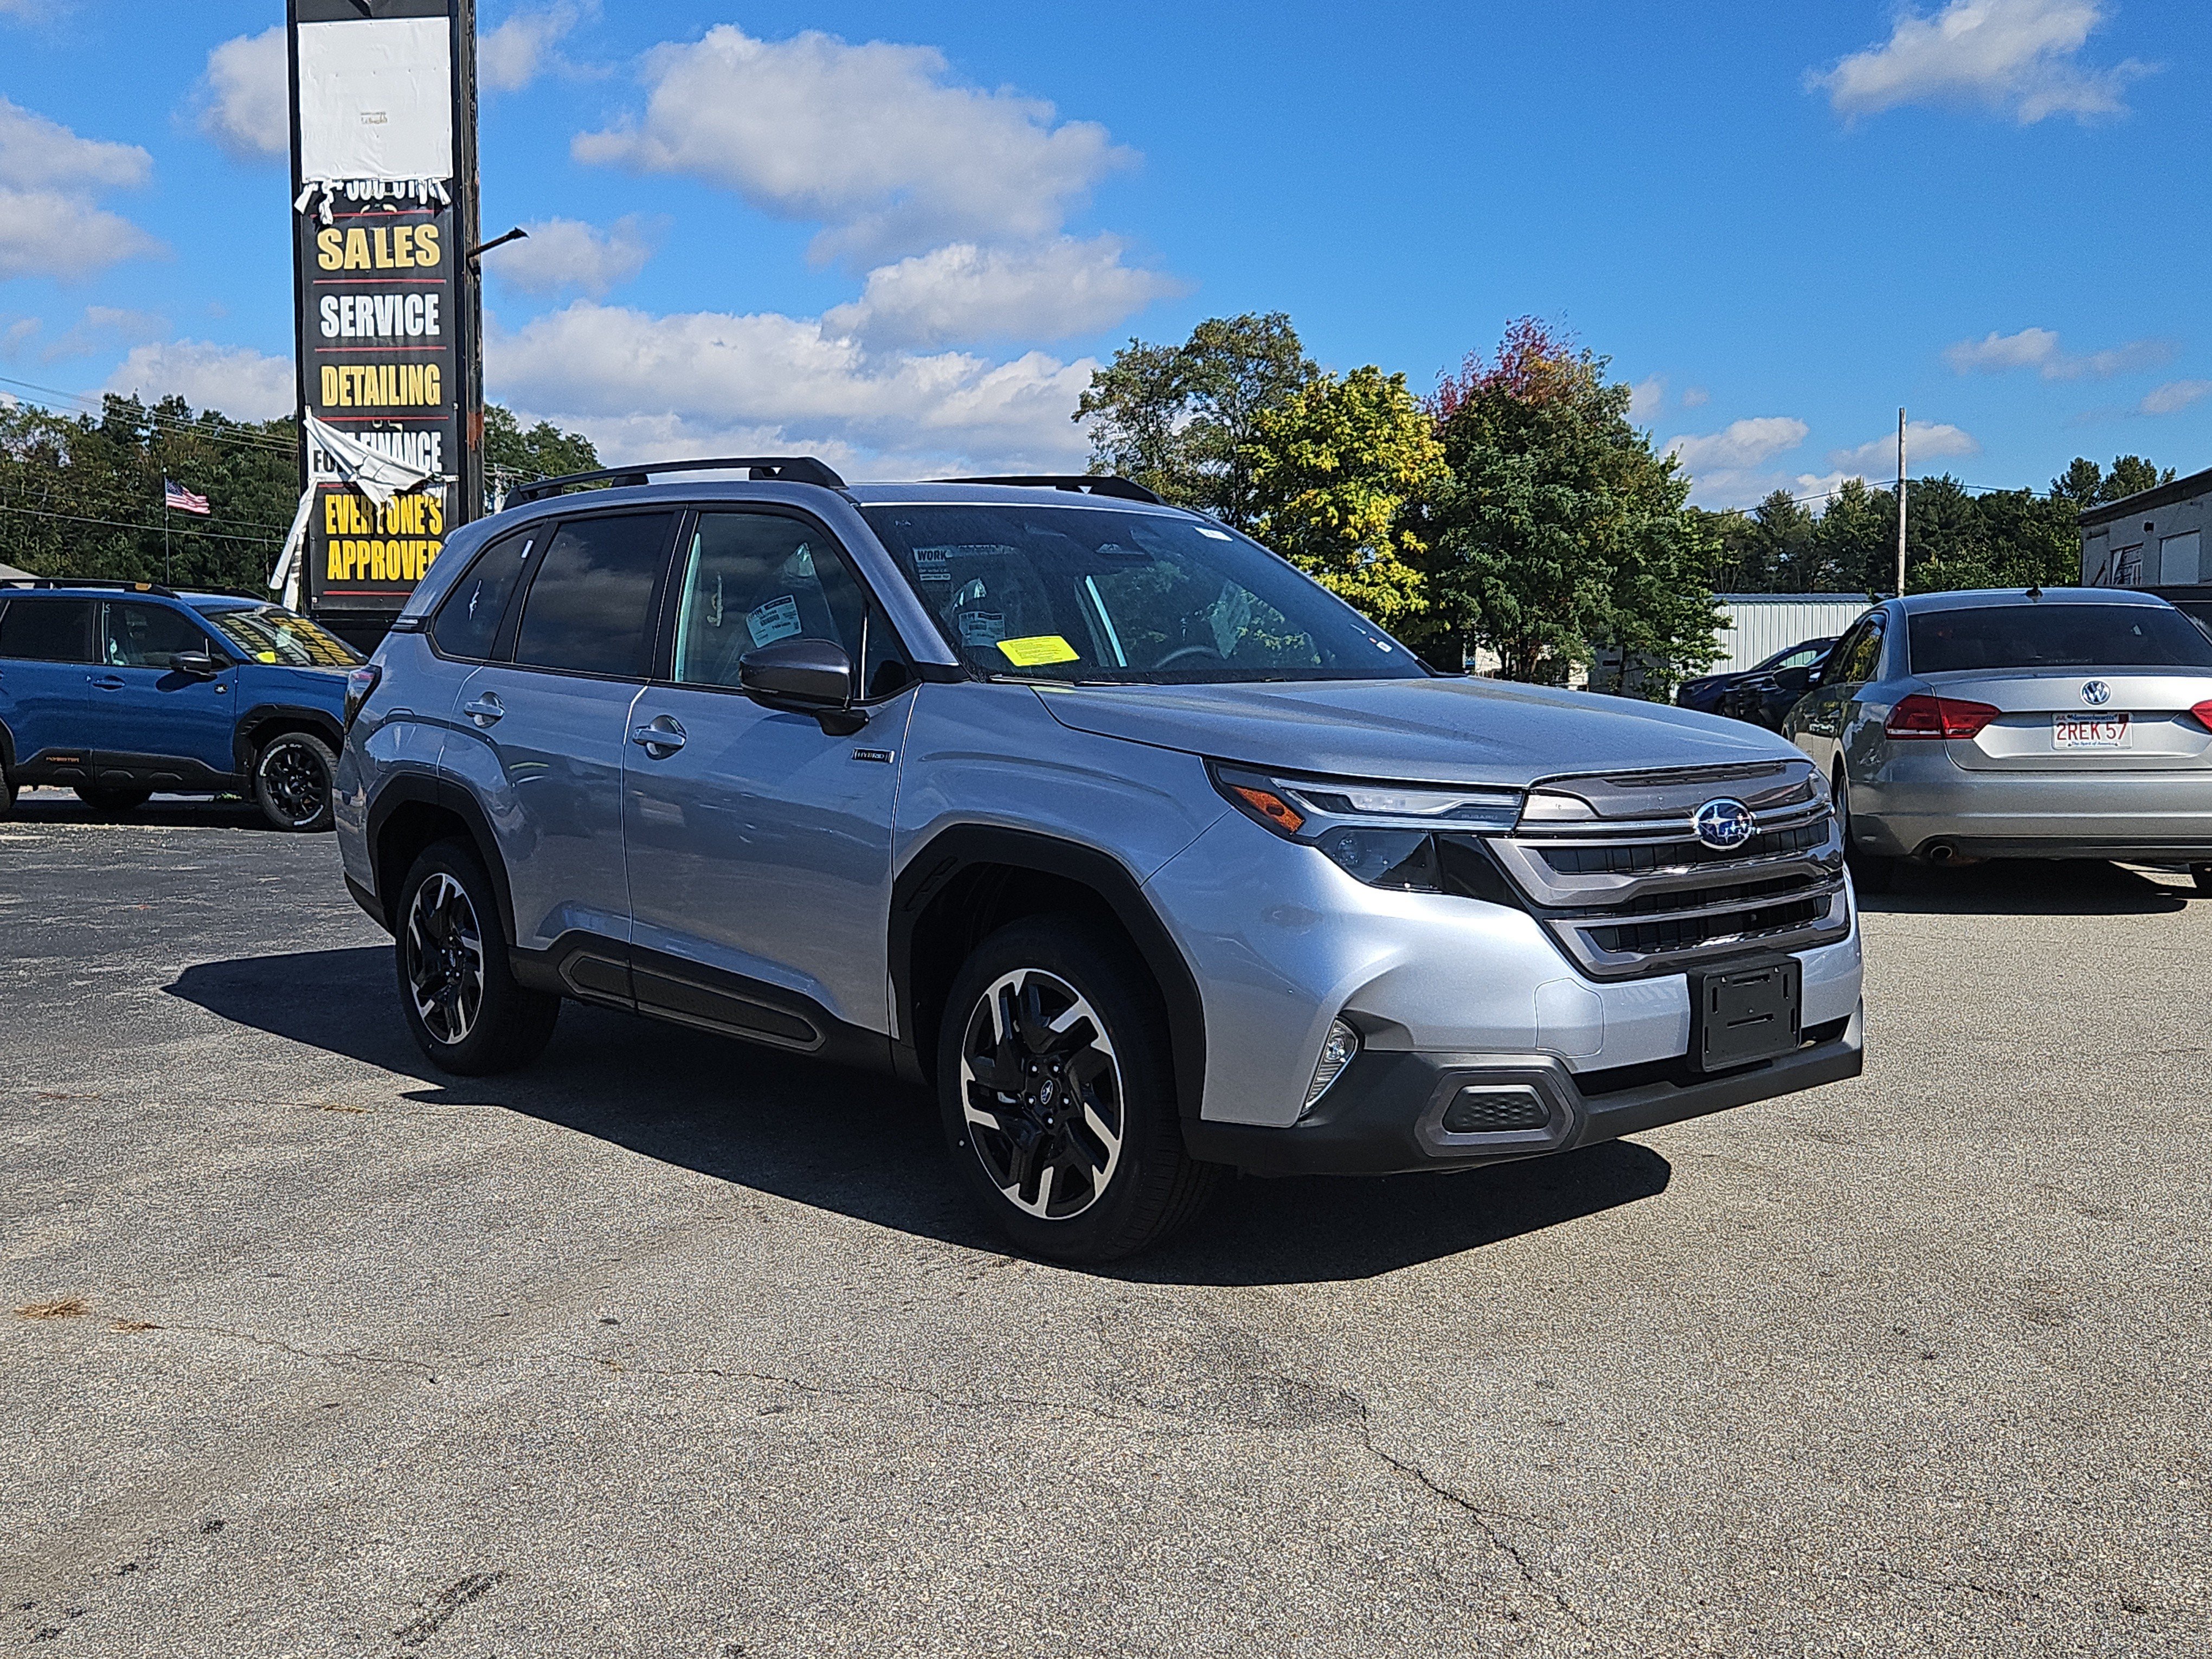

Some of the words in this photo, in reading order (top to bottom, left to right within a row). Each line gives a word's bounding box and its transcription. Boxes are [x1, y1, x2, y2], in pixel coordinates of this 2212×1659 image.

[318, 224, 440, 270] SALES
[320, 294, 440, 337] SERVICE
[321, 364, 441, 406] DETAILING
[917, 550, 947, 561] WORK
[2057, 722, 2101, 740] 2REK
[2106, 722, 2127, 740] 57
